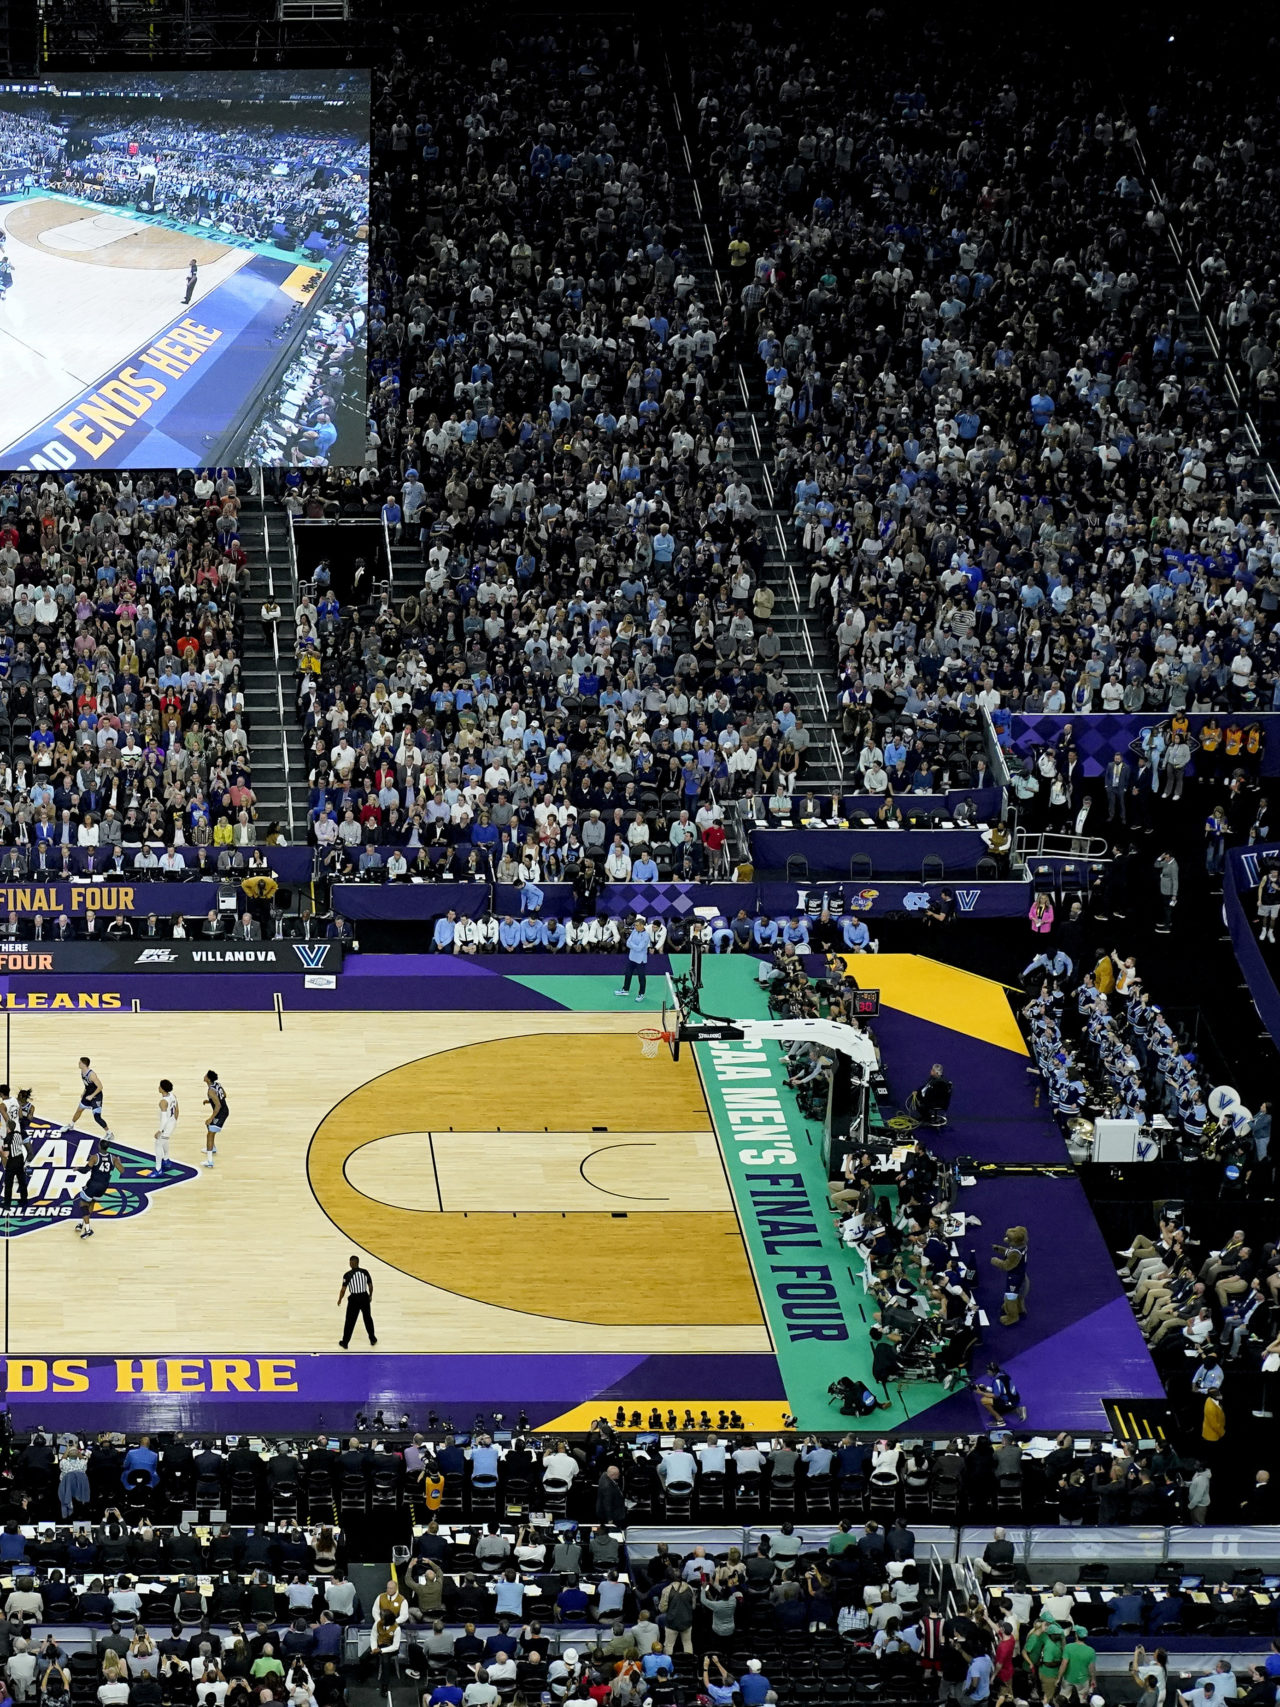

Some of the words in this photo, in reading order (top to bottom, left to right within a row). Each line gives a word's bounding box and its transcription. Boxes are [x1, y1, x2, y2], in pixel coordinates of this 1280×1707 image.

[53, 366, 167, 461] ENDS
[138, 317, 224, 380] HERE
[71, 887, 135, 911] FOUR
[136, 954, 179, 962] EAST
[191, 951, 277, 962] VILLANOVA
[858, 1002, 873, 1013] 30
[720, 1087, 798, 1165] MEN'S
[99, 1161, 111, 1172] 43
[744, 1173, 823, 1256] FINAL
[770, 1264, 850, 1343] FOUR
[114, 1358, 299, 1392] HERE
